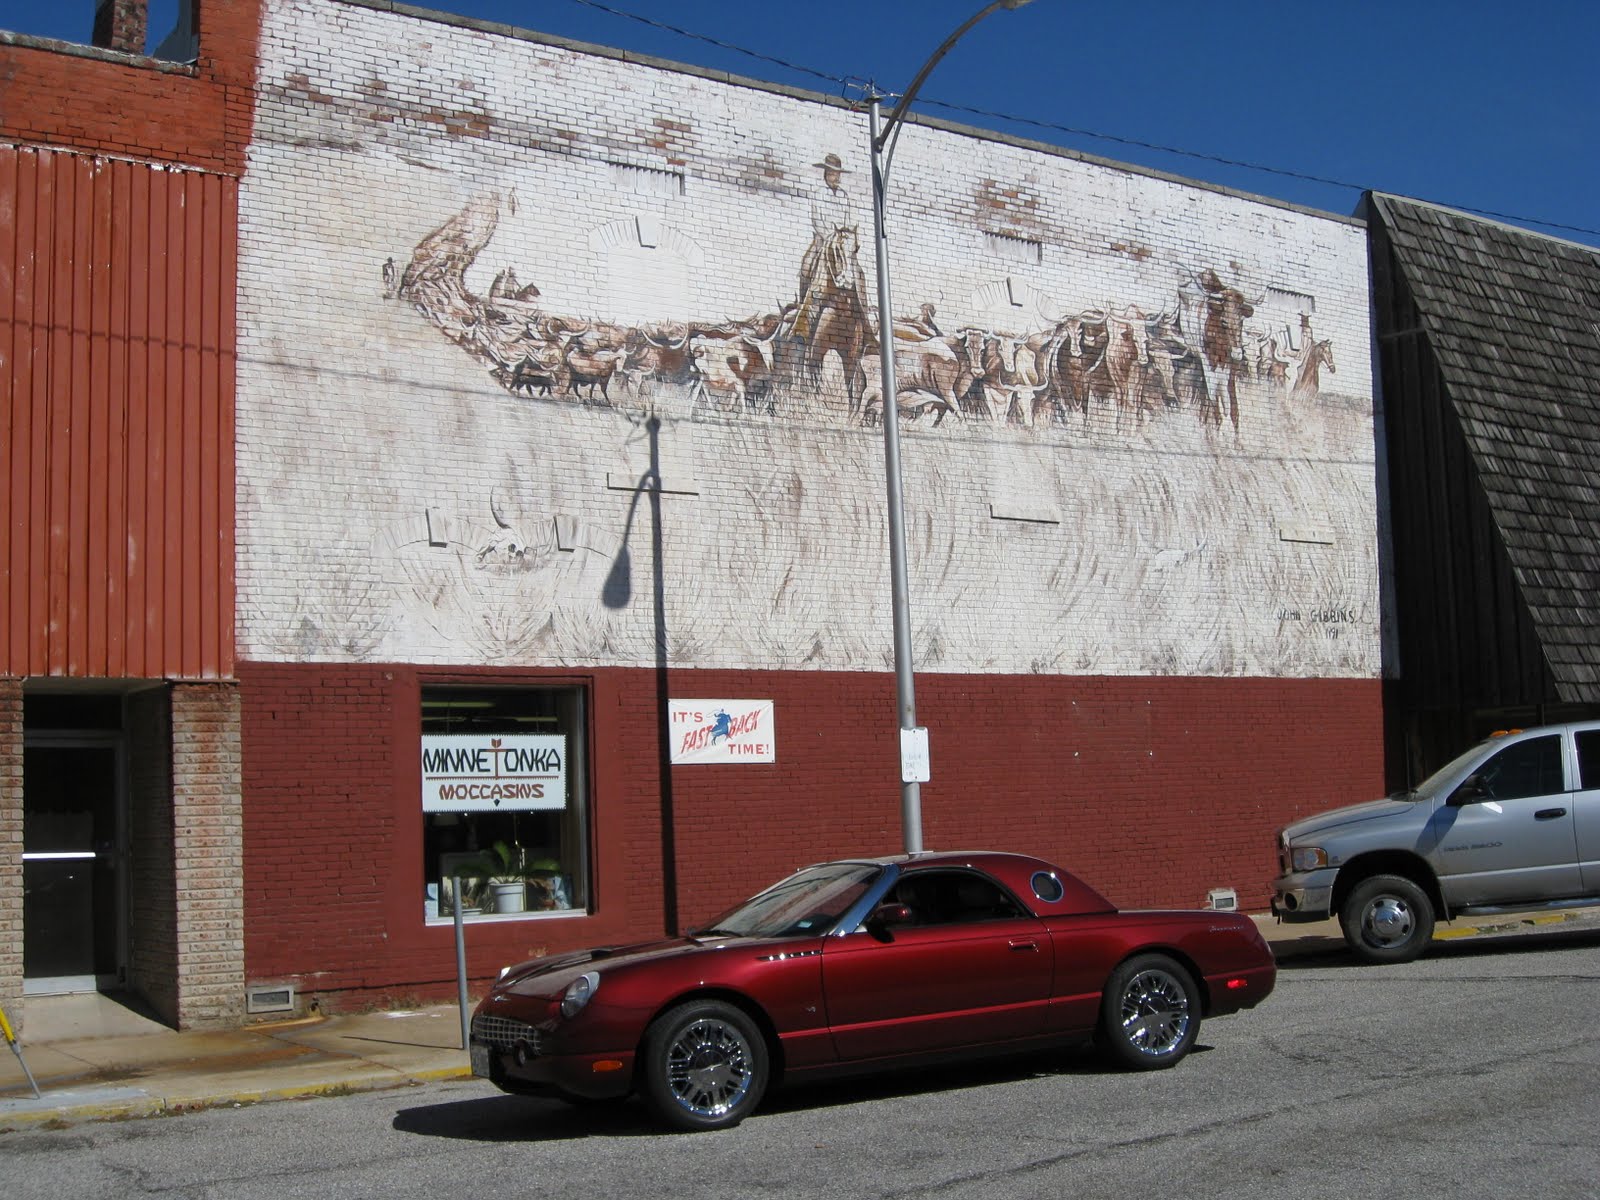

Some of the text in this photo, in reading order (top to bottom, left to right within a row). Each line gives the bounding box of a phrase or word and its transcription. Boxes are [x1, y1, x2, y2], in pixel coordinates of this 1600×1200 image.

[673, 711, 704, 723] IT'S
[680, 709, 761, 754] FAST BACK
[728, 743, 770, 755] TIME!
[422, 748, 562, 780] MINNETONKA
[438, 783, 545, 801] MOCCASINS
